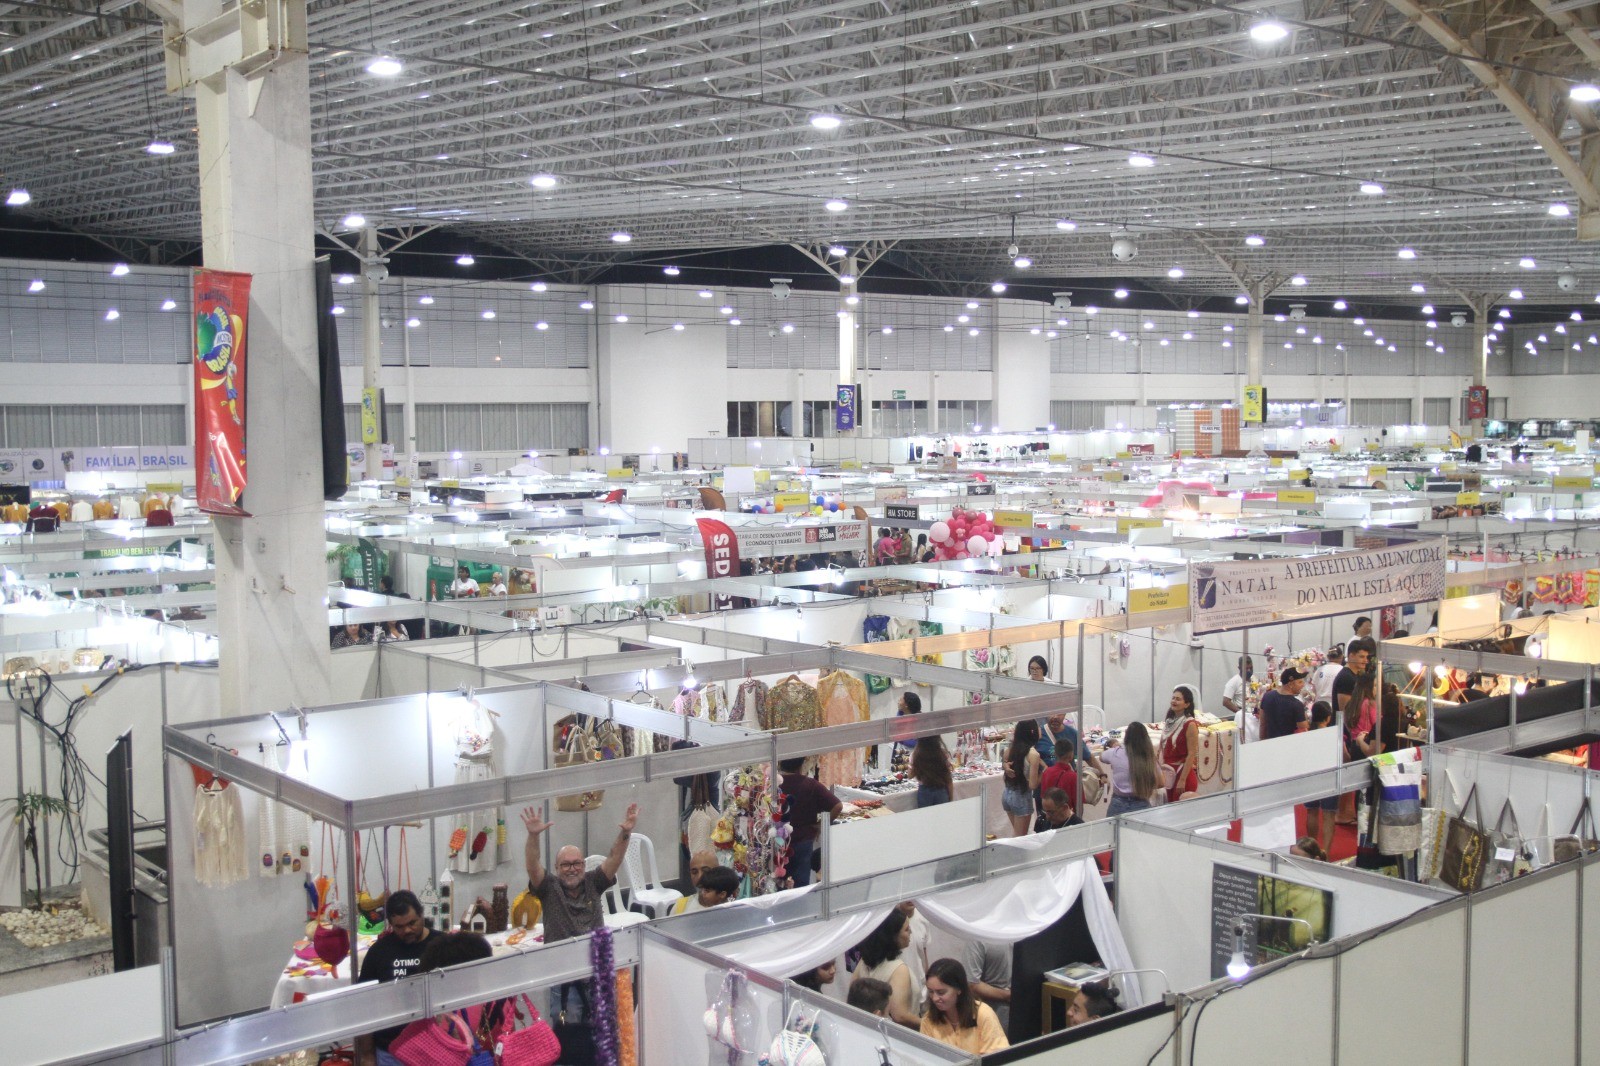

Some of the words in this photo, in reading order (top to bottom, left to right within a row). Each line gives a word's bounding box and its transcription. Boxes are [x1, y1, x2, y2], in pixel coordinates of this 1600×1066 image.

[206, 345, 230, 372] BRASIL
[86, 454, 136, 468] FAMÍLIA
[142, 455, 188, 466] BRASIL
[897, 509, 916, 518] STORE
[760, 530, 802, 539] DESENVOLVIMENTO
[778, 538, 802, 546] TRABALHO
[100, 548, 129, 557] TRABALHO
[130, 547, 143, 556] BEM
[1284, 564, 1294, 580] A
[1296, 555, 1374, 578] PREFEITURA
[1376, 546, 1442, 568] MUNICIPAL
[713, 533, 734, 610] SEDST
[1222, 576, 1278, 596] NATAL
[1297, 587, 1316, 606] DO
[1319, 582, 1360, 602] NATAL
[1364, 573, 1392, 596] ESTÁ
[1232, 876, 1252, 884] chamou
[1231, 882, 1246, 890] Smith
[393, 958, 420, 967] ÓTIMO
